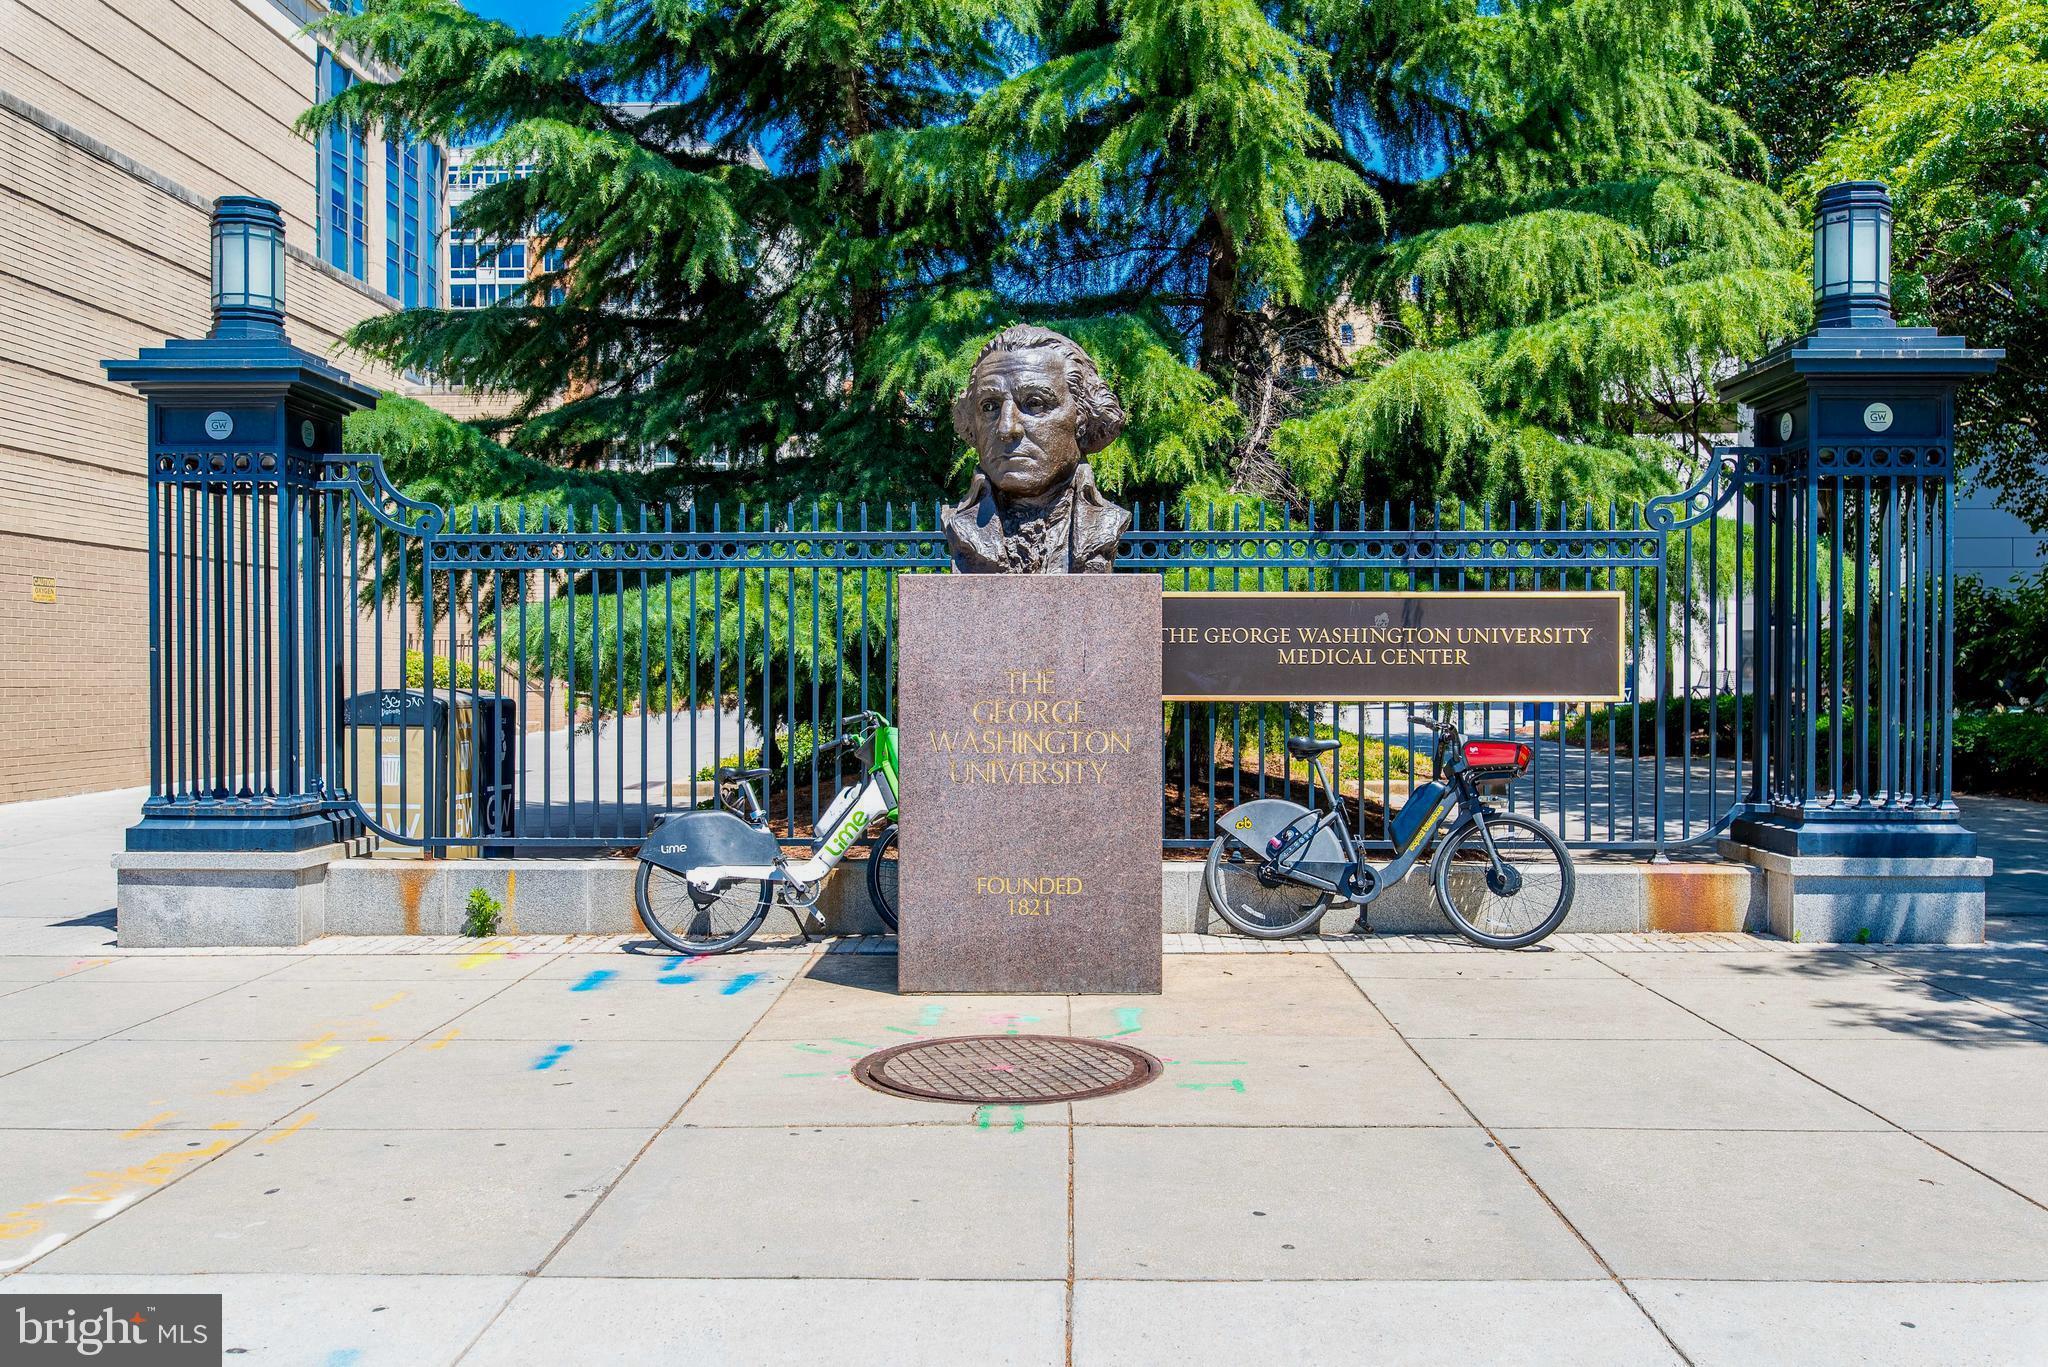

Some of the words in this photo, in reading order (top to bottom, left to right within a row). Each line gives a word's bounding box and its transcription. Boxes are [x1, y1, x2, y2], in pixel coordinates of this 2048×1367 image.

[211, 422, 227, 430] GW
[1869, 413, 1887, 422] GW
[1203, 627, 1291, 644] GEORGE
[1296, 627, 1451, 644] WASHINGTON
[1456, 627, 1593, 644] UNIVERSITY
[1277, 648, 1377, 665] MEDICAL
[1380, 648, 1470, 665] CENTER
[1004, 670, 1056, 694] THE
[972, 700, 1087, 724] GEORGE
[929, 729, 1130, 753] WASHINGTON
[949, 759, 1108, 784] UNIVERSITY
[825, 810, 869, 857] Lime
[1409, 829, 1426, 851] capital
[1421, 805, 1444, 831] bikeshare
[661, 843, 688, 854] Lime
[977, 877, 1083, 895] FOUNDED
[1008, 898, 1051, 916] 1821
